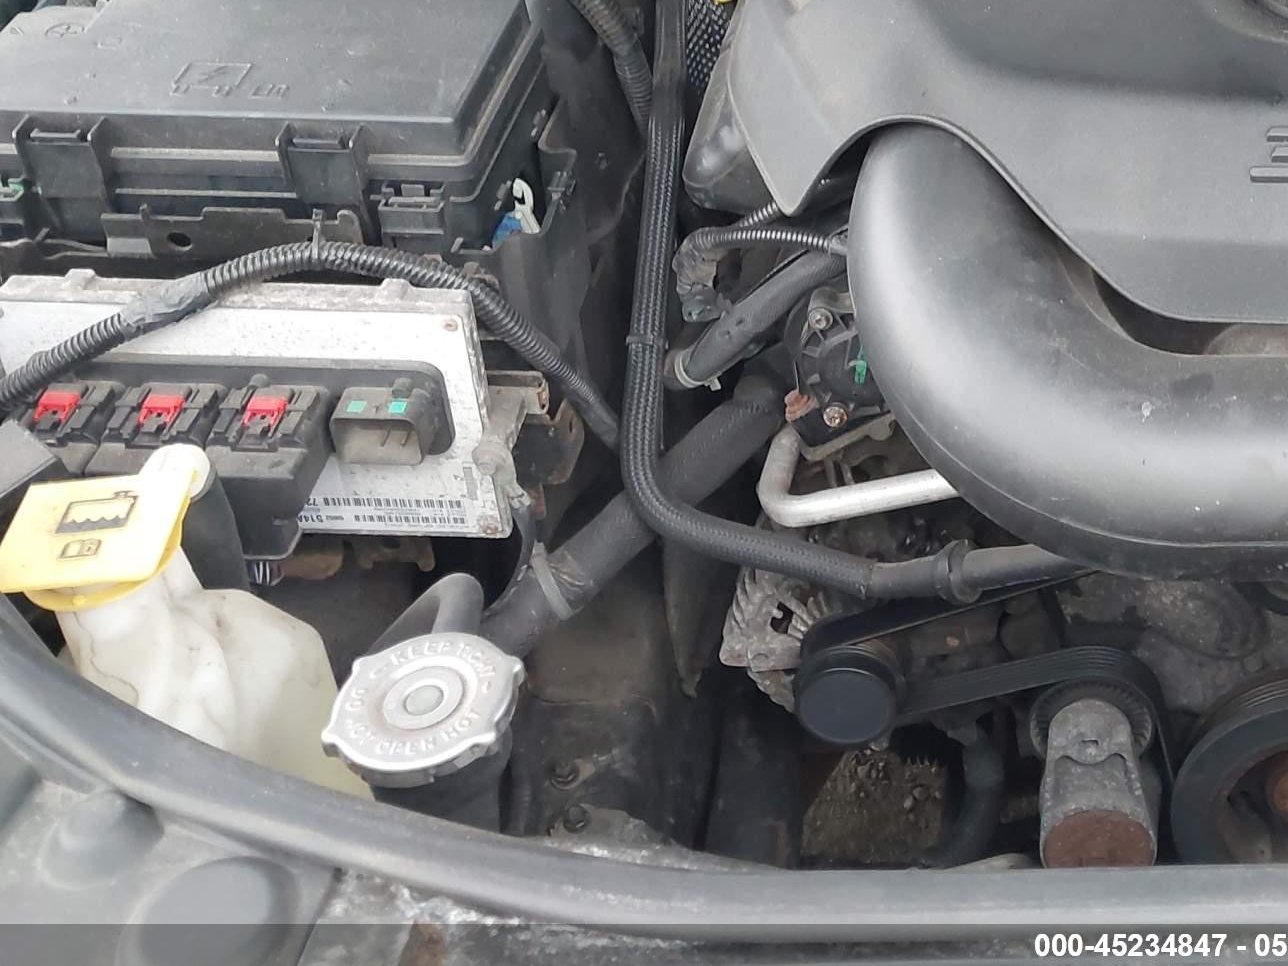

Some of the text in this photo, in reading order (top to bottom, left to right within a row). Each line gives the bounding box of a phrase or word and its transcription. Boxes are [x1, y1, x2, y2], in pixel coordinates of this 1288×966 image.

[389, 641, 451, 666] KEEP
[376, 733, 438, 755] OPEN
[440, 707, 481, 742] HOT
